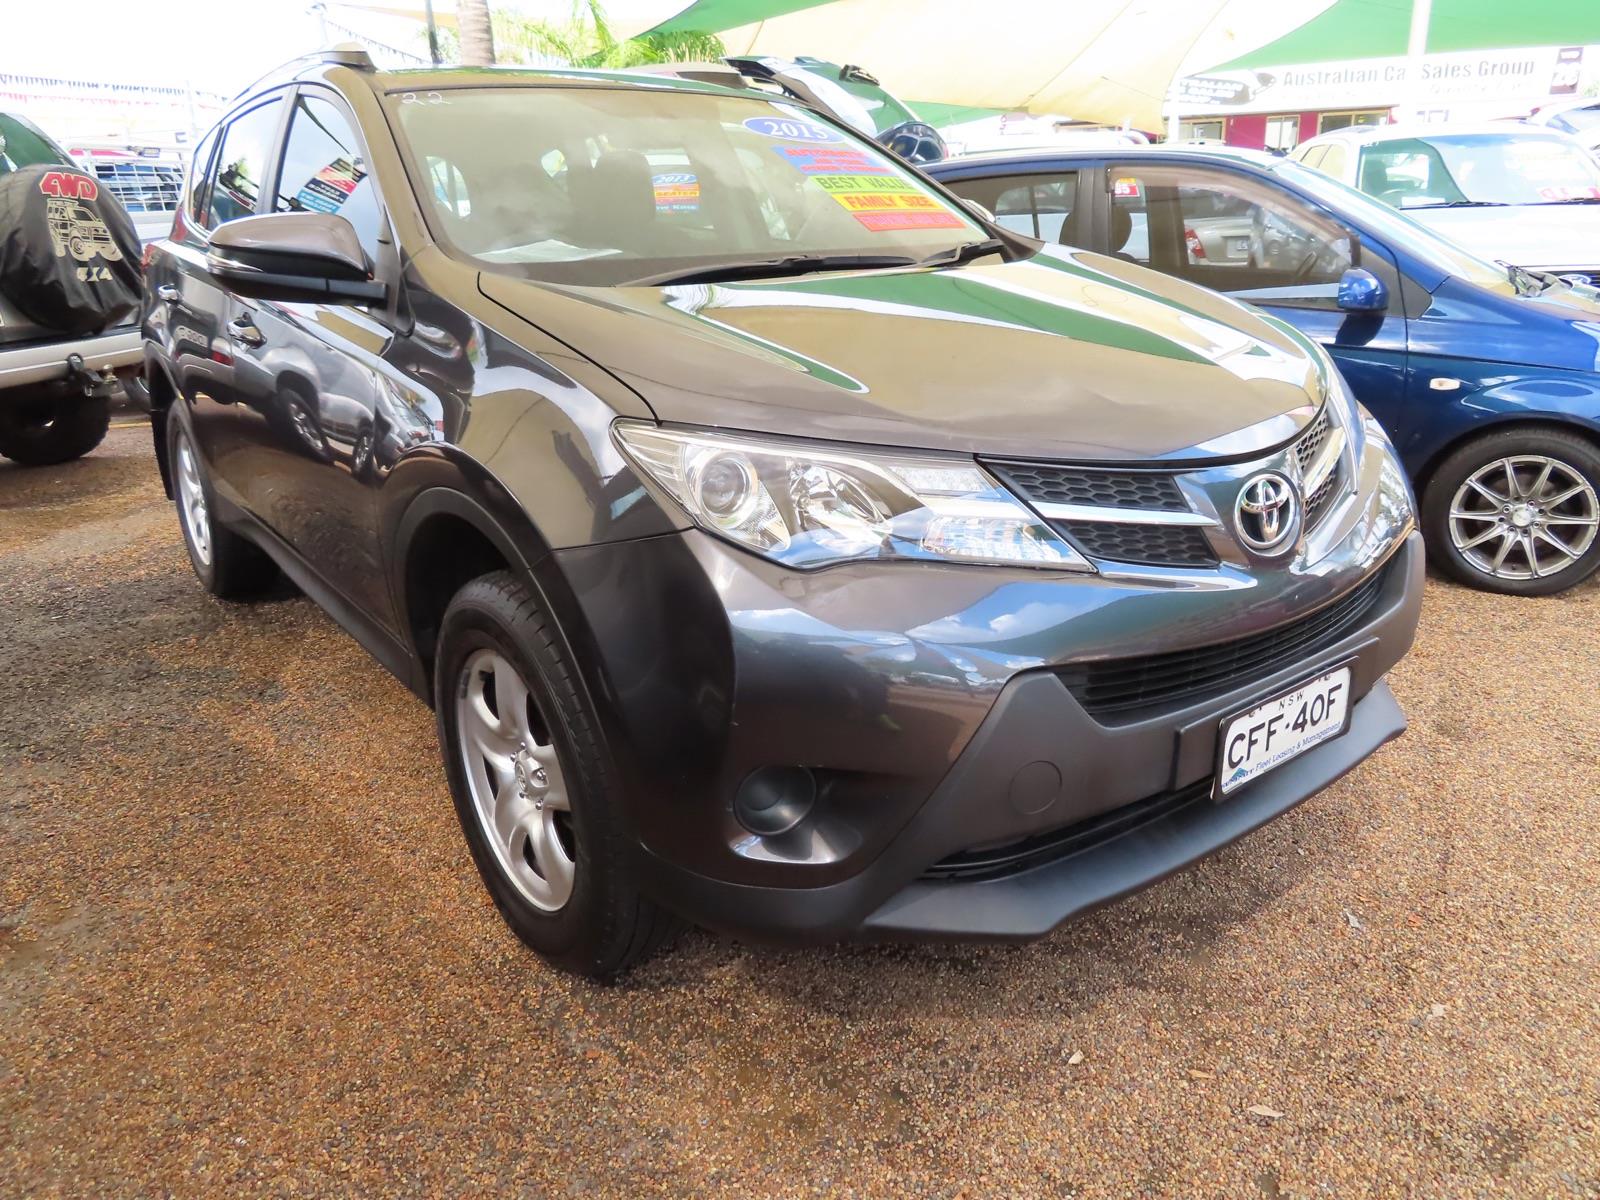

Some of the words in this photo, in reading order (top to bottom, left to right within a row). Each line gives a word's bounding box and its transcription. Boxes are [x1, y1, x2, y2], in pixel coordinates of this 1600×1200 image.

[1283, 67, 1377, 87] Australian
[1384, 65, 1407, 82] Ca
[1421, 62, 1472, 80] Sales
[1478, 60, 1535, 77] Group
[40, 172, 98, 201] 4WD
[815, 177, 861, 189] BEST
[865, 177, 917, 190] VALUE
[843, 195, 899, 209] FAMILY
[899, 195, 938, 208] SIZE
[1278, 689, 1305, 711] NSW
[1272, 744, 1296, 763] Leasing
[1302, 721, 1342, 748] Management
